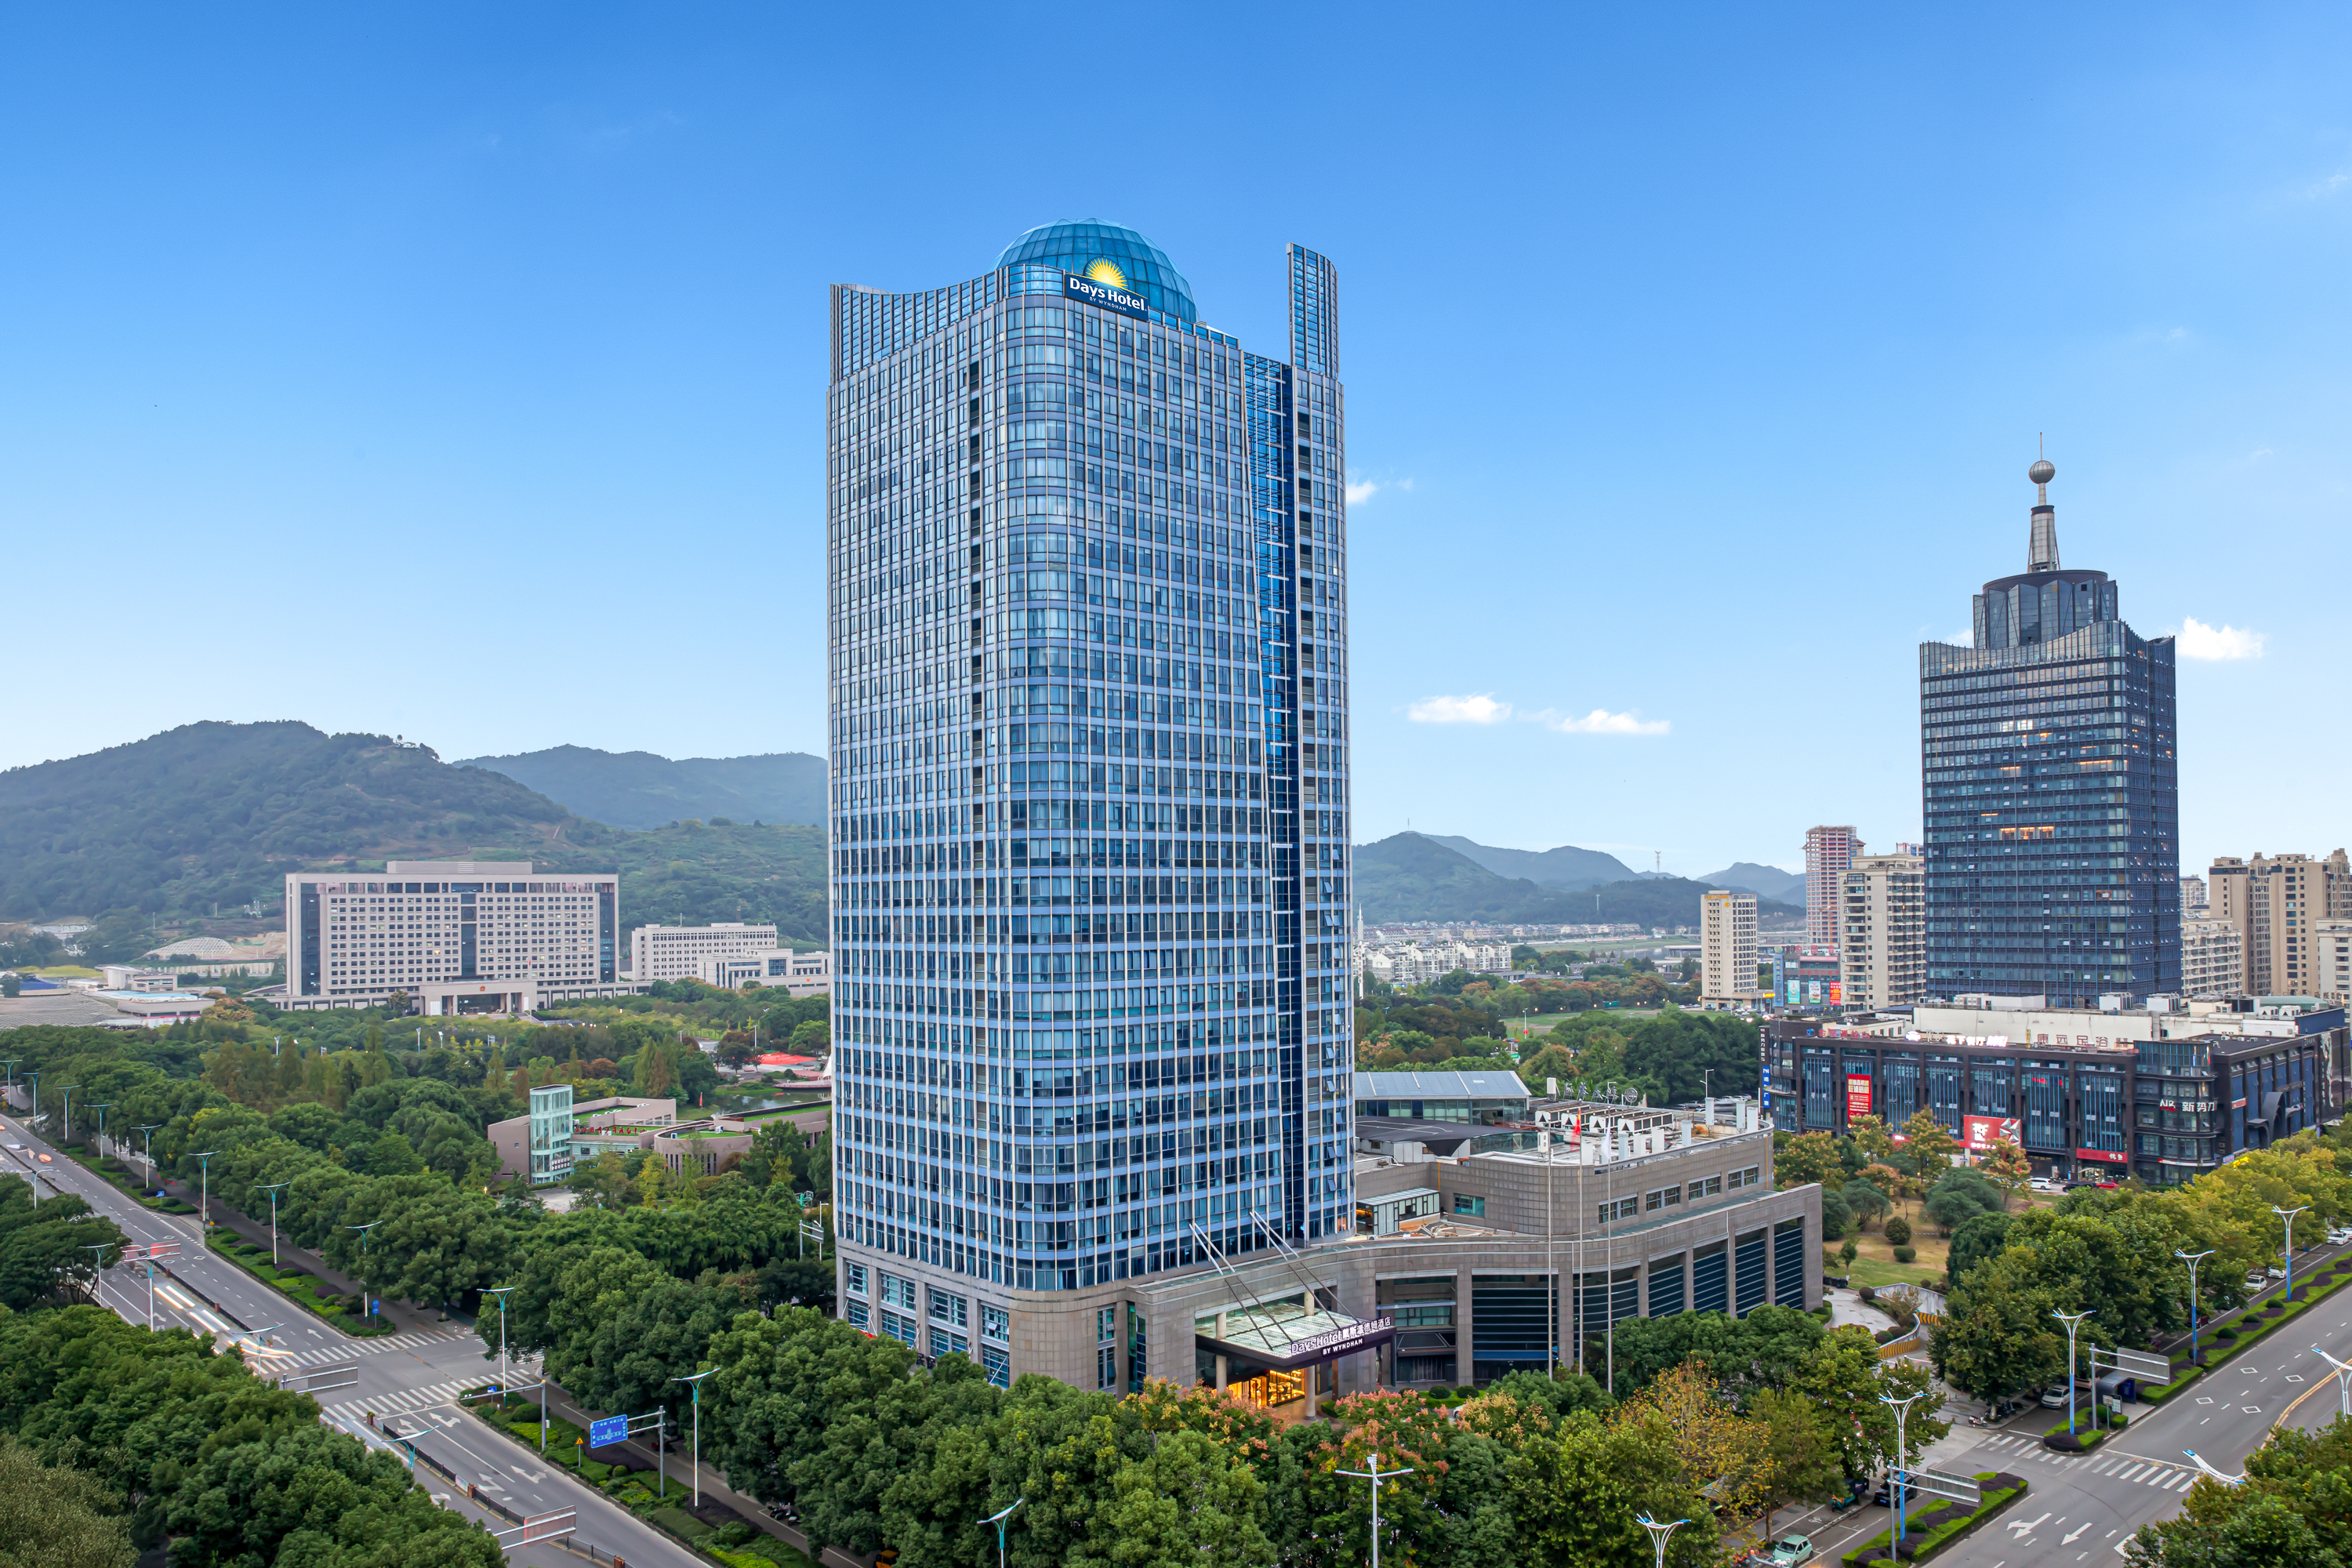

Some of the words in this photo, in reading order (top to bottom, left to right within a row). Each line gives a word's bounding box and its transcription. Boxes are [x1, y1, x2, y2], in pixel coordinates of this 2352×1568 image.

[1069, 277, 1105, 298] Days
[1108, 289, 1145, 311] Hotel
[1098, 299, 1127, 311] WYNDHAM
[2182, 1102, 2215, 1112] 新势力
[1291, 1340, 1316, 1353] Days
[1317, 1330, 1341, 1347] Hotel
[1333, 1338, 1363, 1352] WYNDHAM
